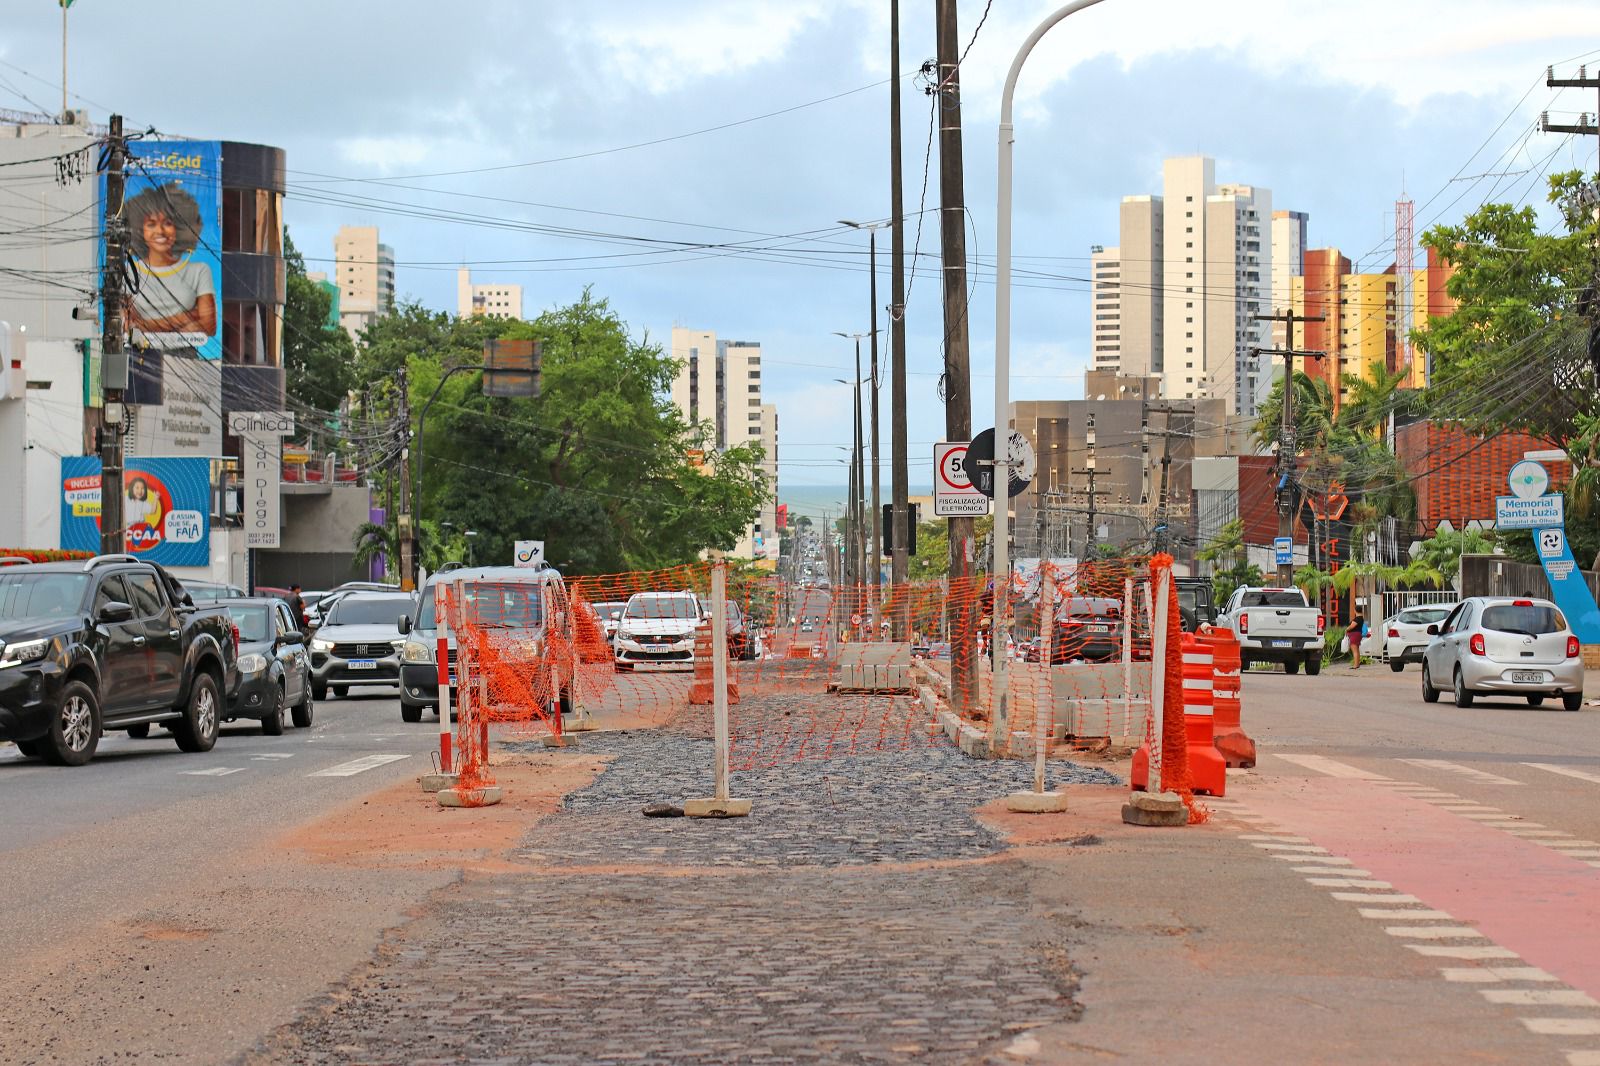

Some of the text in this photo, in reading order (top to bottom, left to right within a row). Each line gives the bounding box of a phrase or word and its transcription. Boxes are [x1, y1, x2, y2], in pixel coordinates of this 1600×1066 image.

[256, 440, 266, 469] San
[76, 491, 101, 501] partir
[1505, 499, 1553, 508] Memorial
[1499, 508, 1558, 518] Santa Luzia
[168, 520, 180, 528] QUE
[126, 529, 161, 541] CCAA
[176, 523, 200, 539] FALA
[356, 644, 369, 655] FIAT
